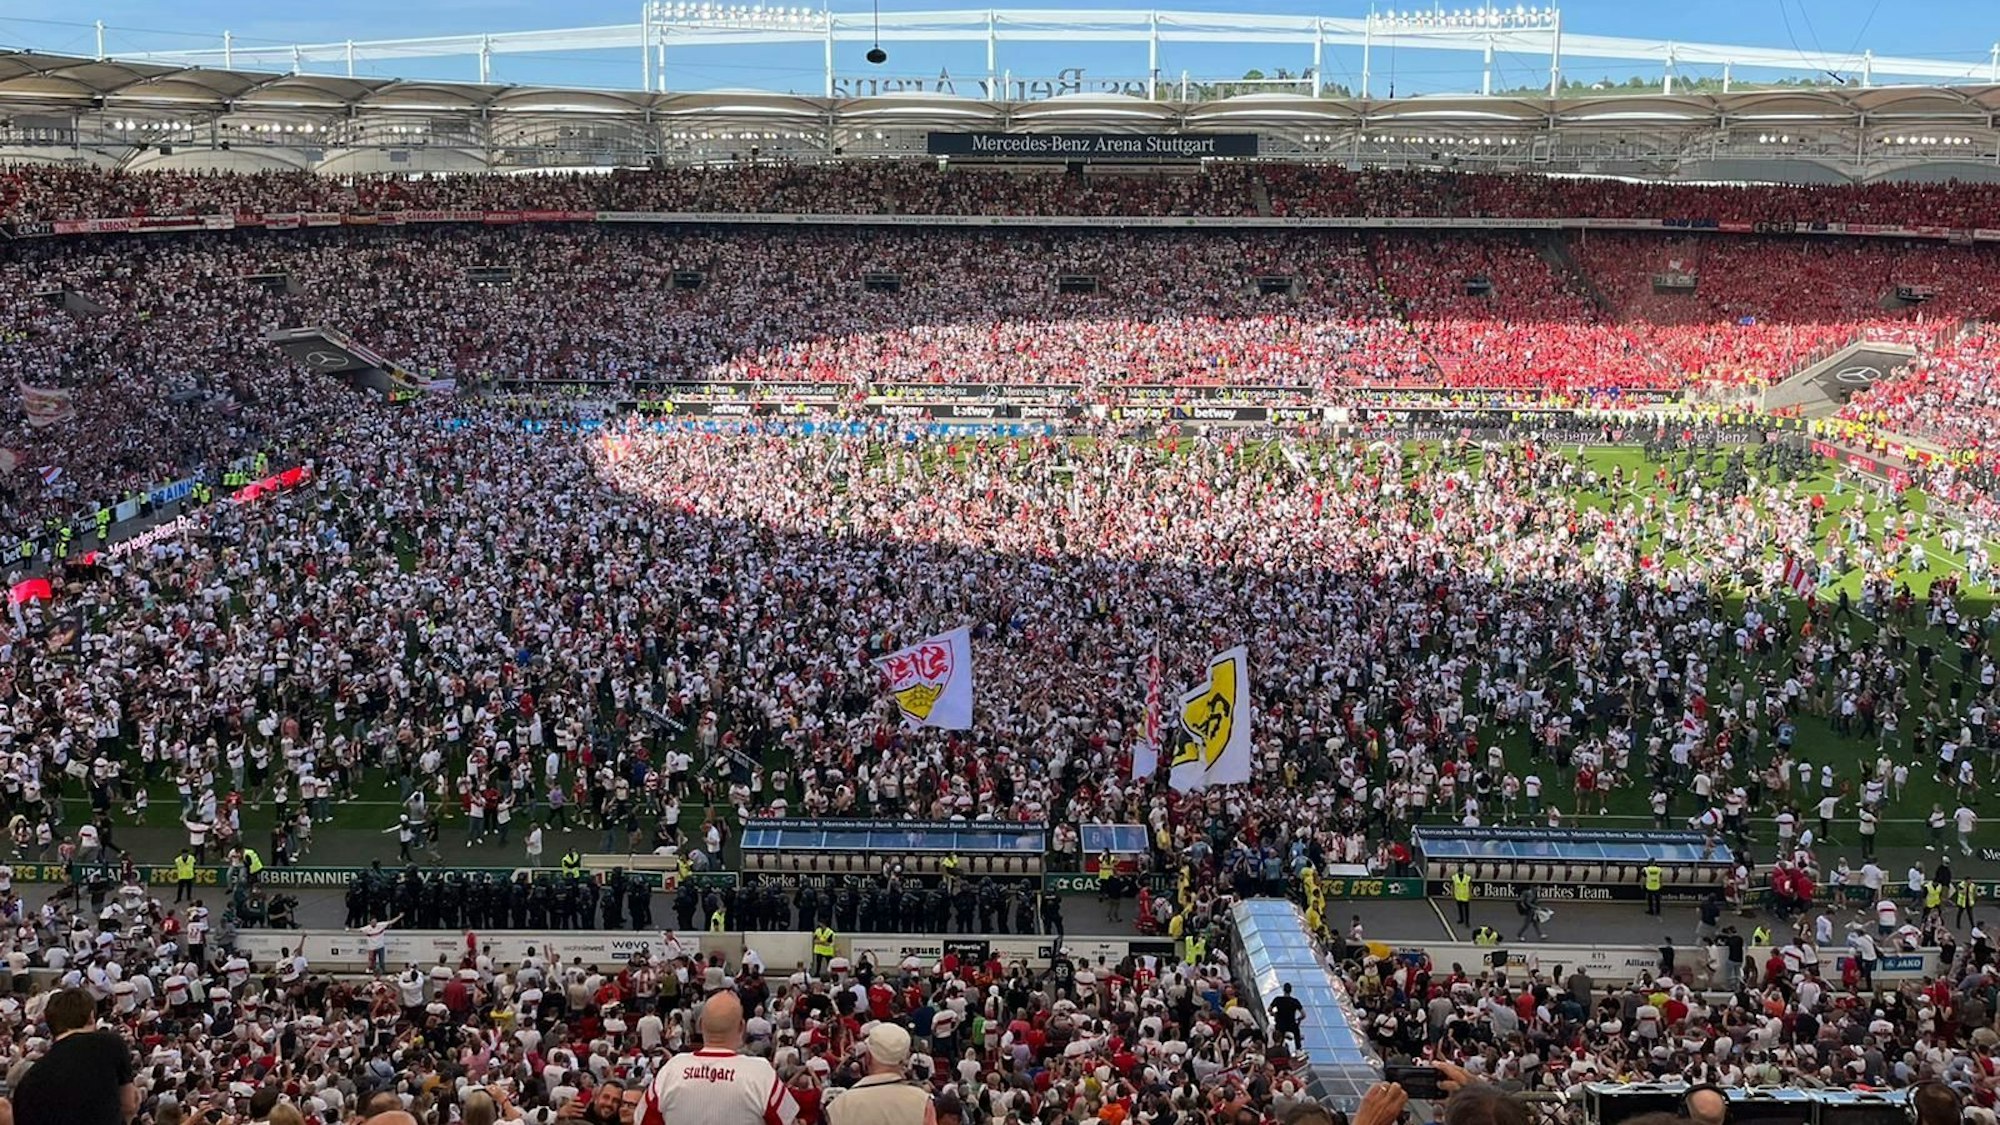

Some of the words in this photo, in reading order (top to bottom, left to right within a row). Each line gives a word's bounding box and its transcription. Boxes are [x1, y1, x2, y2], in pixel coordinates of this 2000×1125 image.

[972, 136, 1090, 152] Mercedes-Benz
[1095, 136, 1141, 152] Arena
[1147, 136, 1215, 155] Stuttgart
[1194, 407, 1237, 420] betway
[1982, 848, 2000, 861] Me
[1321, 879, 1345, 894] TC
[1350, 879, 1384, 896] ITC
[1484, 882, 1519, 898] Bank.
[1577, 885, 1613, 899] Team.
[612, 940, 650, 950] wevo
[1625, 958, 1655, 967] Allianz
[1898, 959, 1921, 967] JAKO
[1056, 967, 1069, 977] 93
